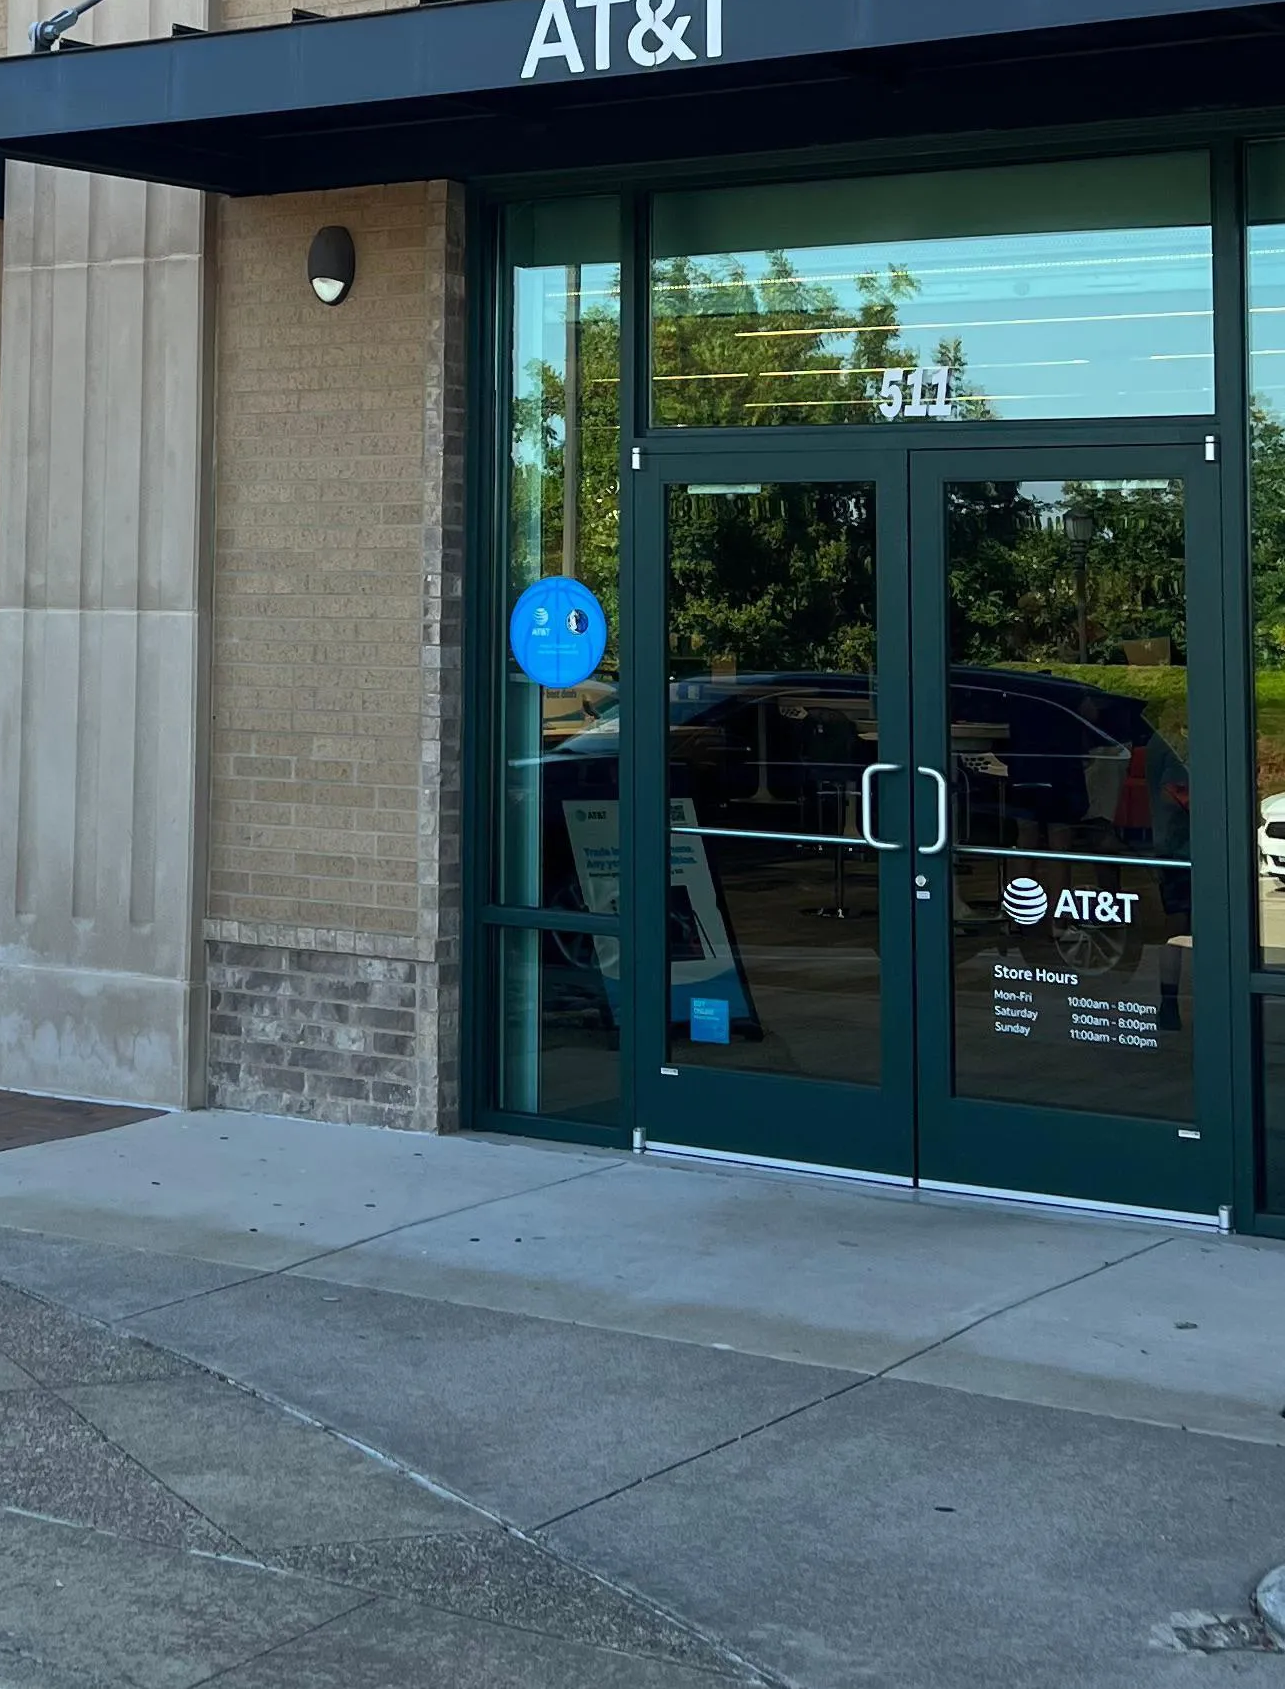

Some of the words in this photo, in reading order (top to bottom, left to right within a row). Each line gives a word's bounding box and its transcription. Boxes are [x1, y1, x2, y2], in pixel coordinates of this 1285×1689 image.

[879, 365, 952, 418] 511
[1053, 889, 1139, 924] AT&T
[994, 964, 1033, 981] Store
[1035, 968, 1079, 985] Hours
[994, 989, 1033, 1002] Mon-Fri
[1068, 996, 1110, 1010] 10:00am
[1117, 1001, 1157, 1016] 8:00pm
[994, 1005, 1039, 1021] Saturday
[1072, 1013, 1110, 1027] 9:00am
[994, 1021, 1031, 1037] Sunday
